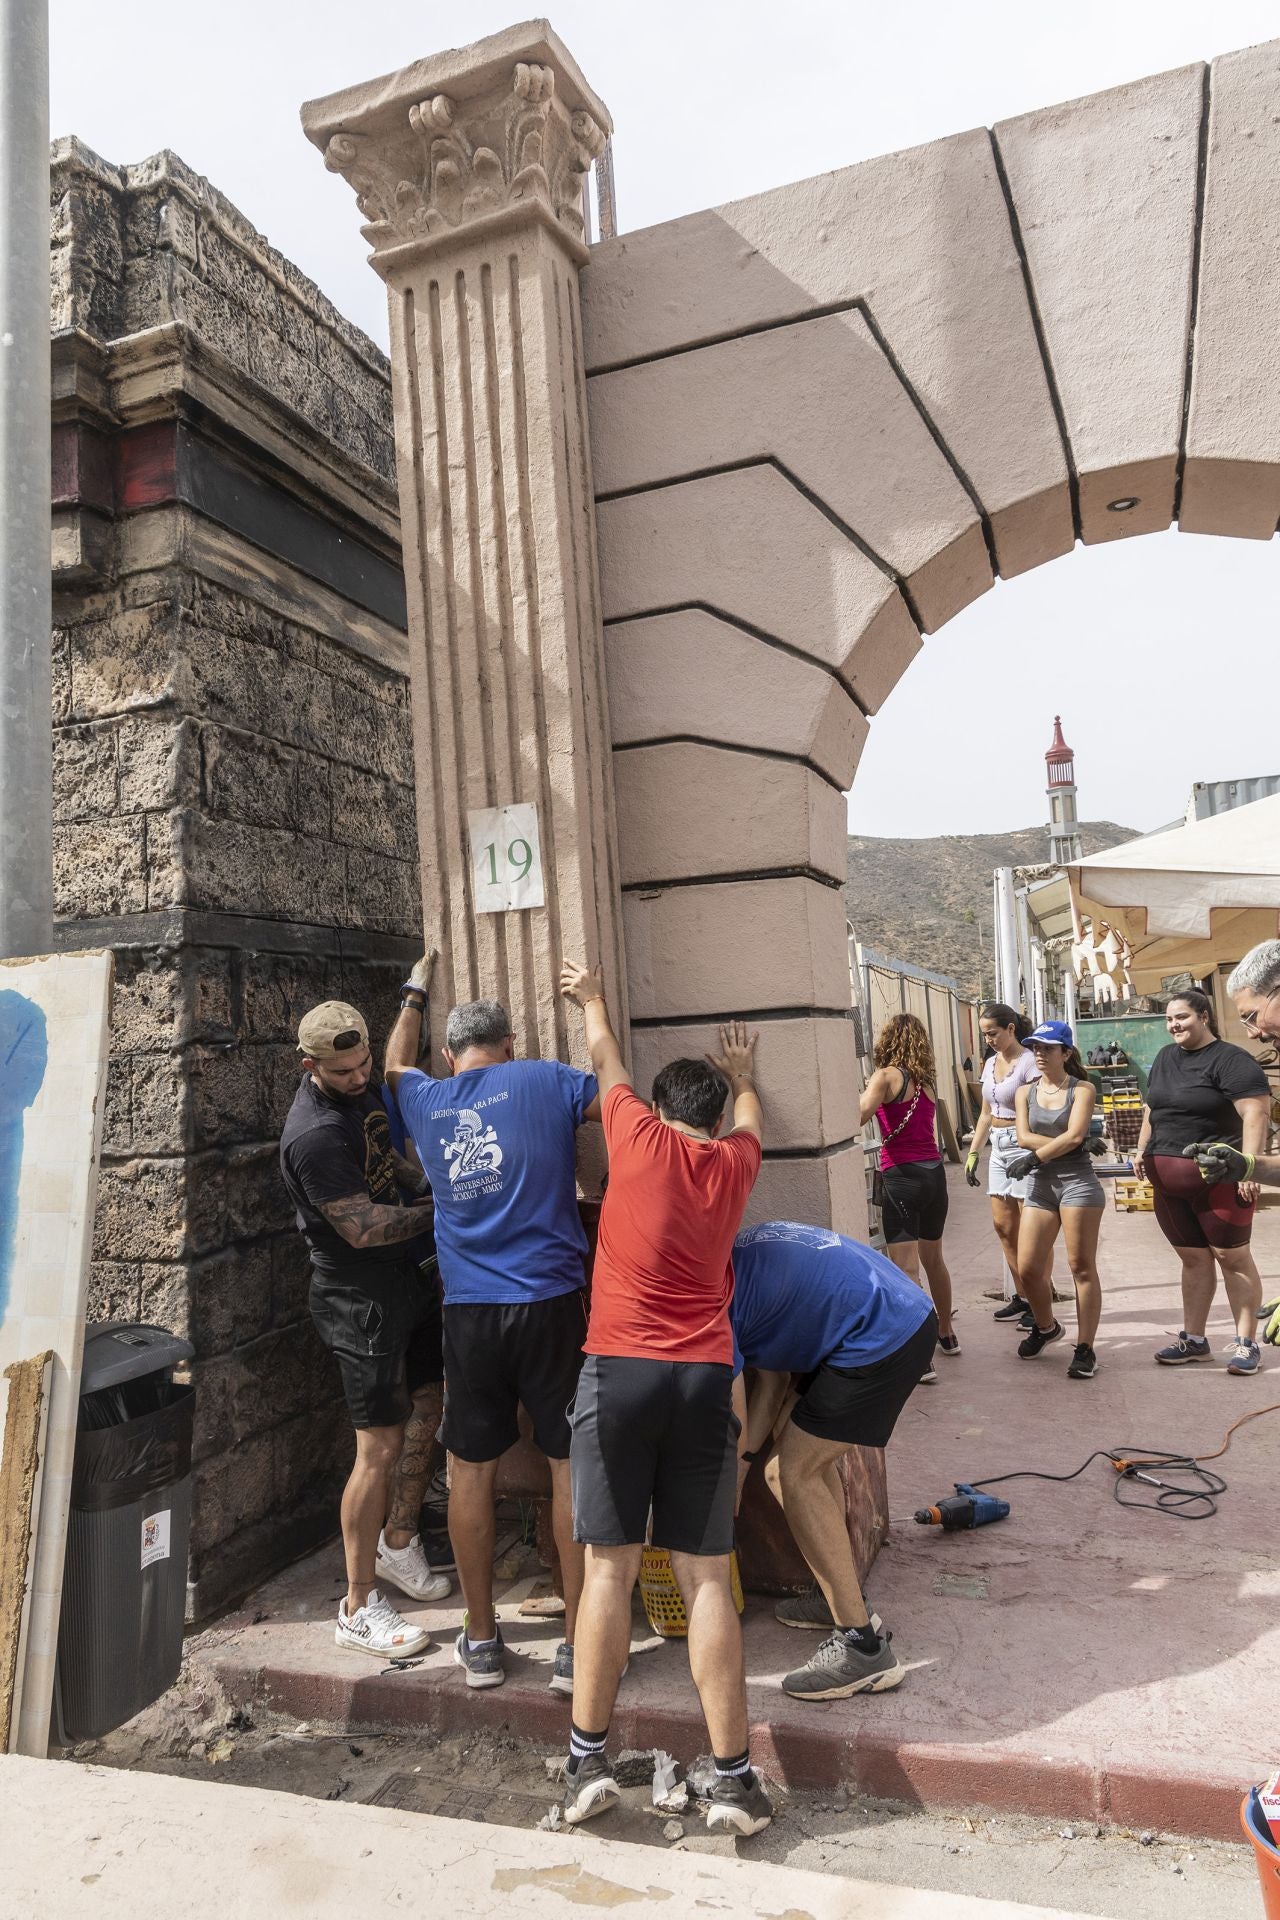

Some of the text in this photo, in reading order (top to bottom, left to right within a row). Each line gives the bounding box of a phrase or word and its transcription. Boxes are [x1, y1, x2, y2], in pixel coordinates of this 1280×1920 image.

[484, 838, 533, 886] 19
[431, 1091, 509, 1120] LEGION ARA PACIS
[452, 1190, 476, 1201] MCMXCI
[482, 1182, 503, 1195] MMXV
[453, 1173, 498, 1191] ANIVERSARIO
[1262, 1796, 1280, 1805] fisc
